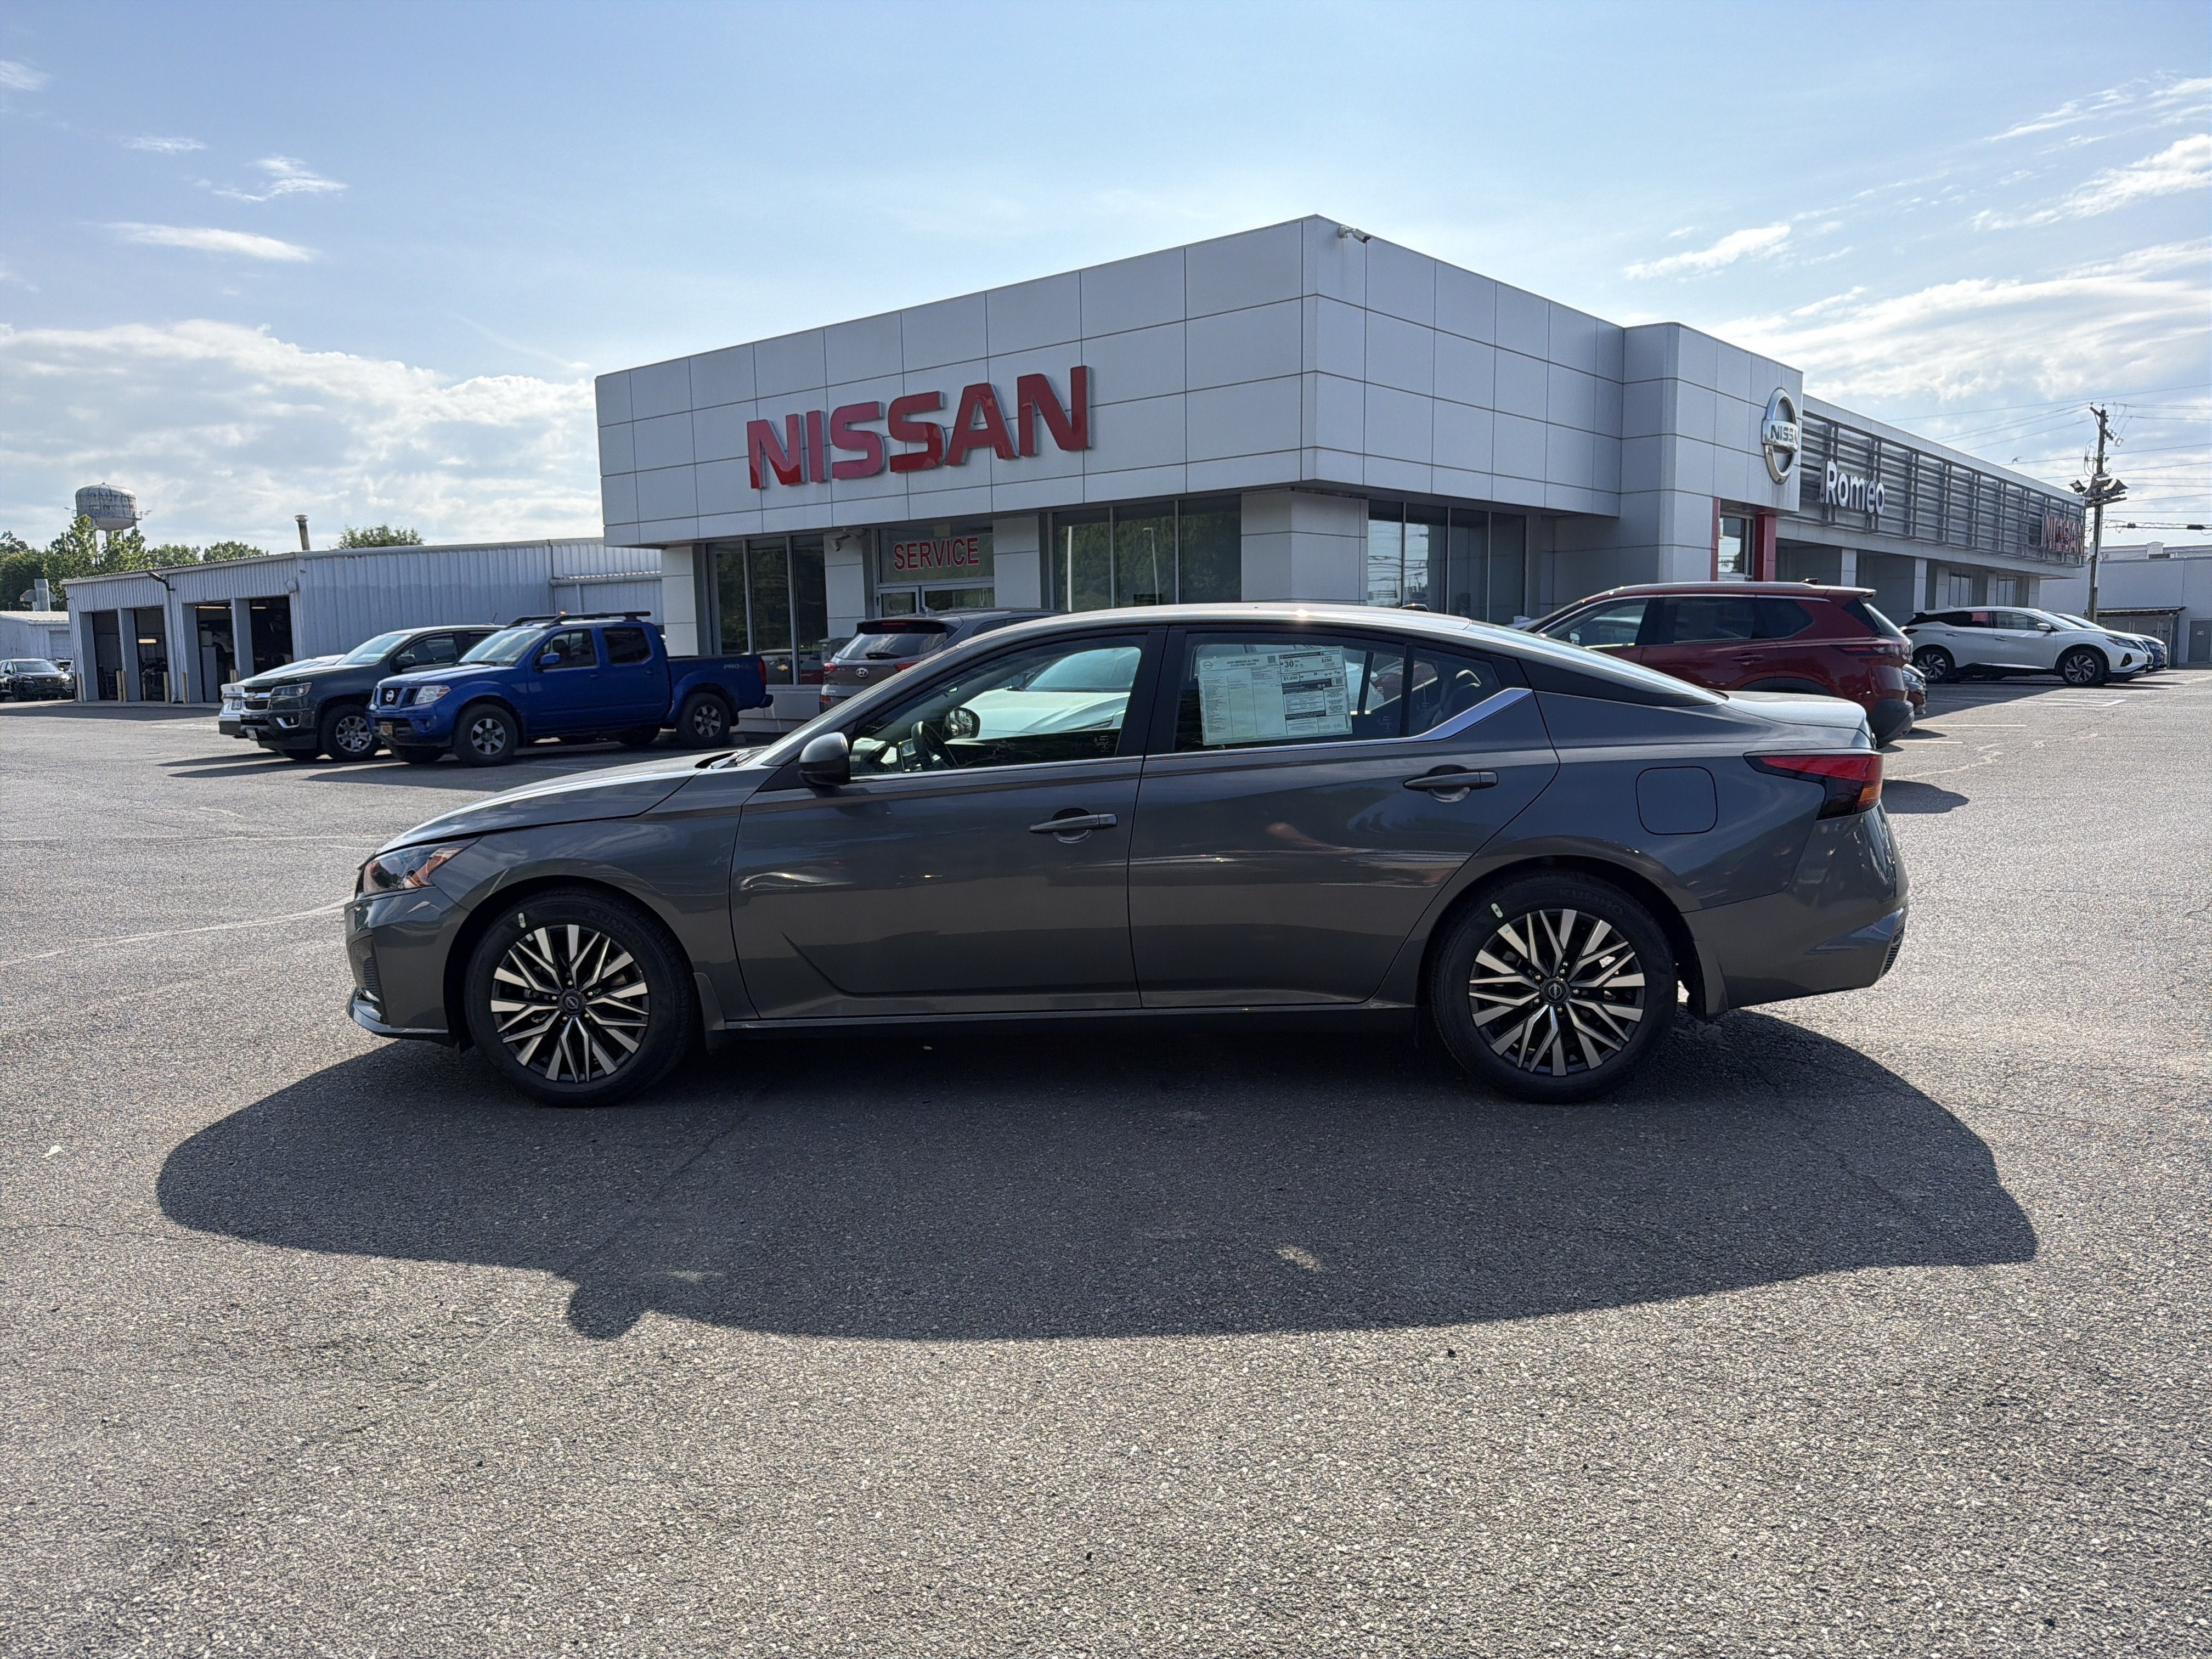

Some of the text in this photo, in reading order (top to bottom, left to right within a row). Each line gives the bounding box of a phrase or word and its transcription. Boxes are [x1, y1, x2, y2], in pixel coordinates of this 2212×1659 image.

[746, 365, 1091, 489] NISSAN
[1770, 425, 1799, 445] NISSA
[1825, 460, 1885, 515] Romeo
[893, 537, 980, 571] SERVICE
[2044, 514, 2084, 555] NISSAN
